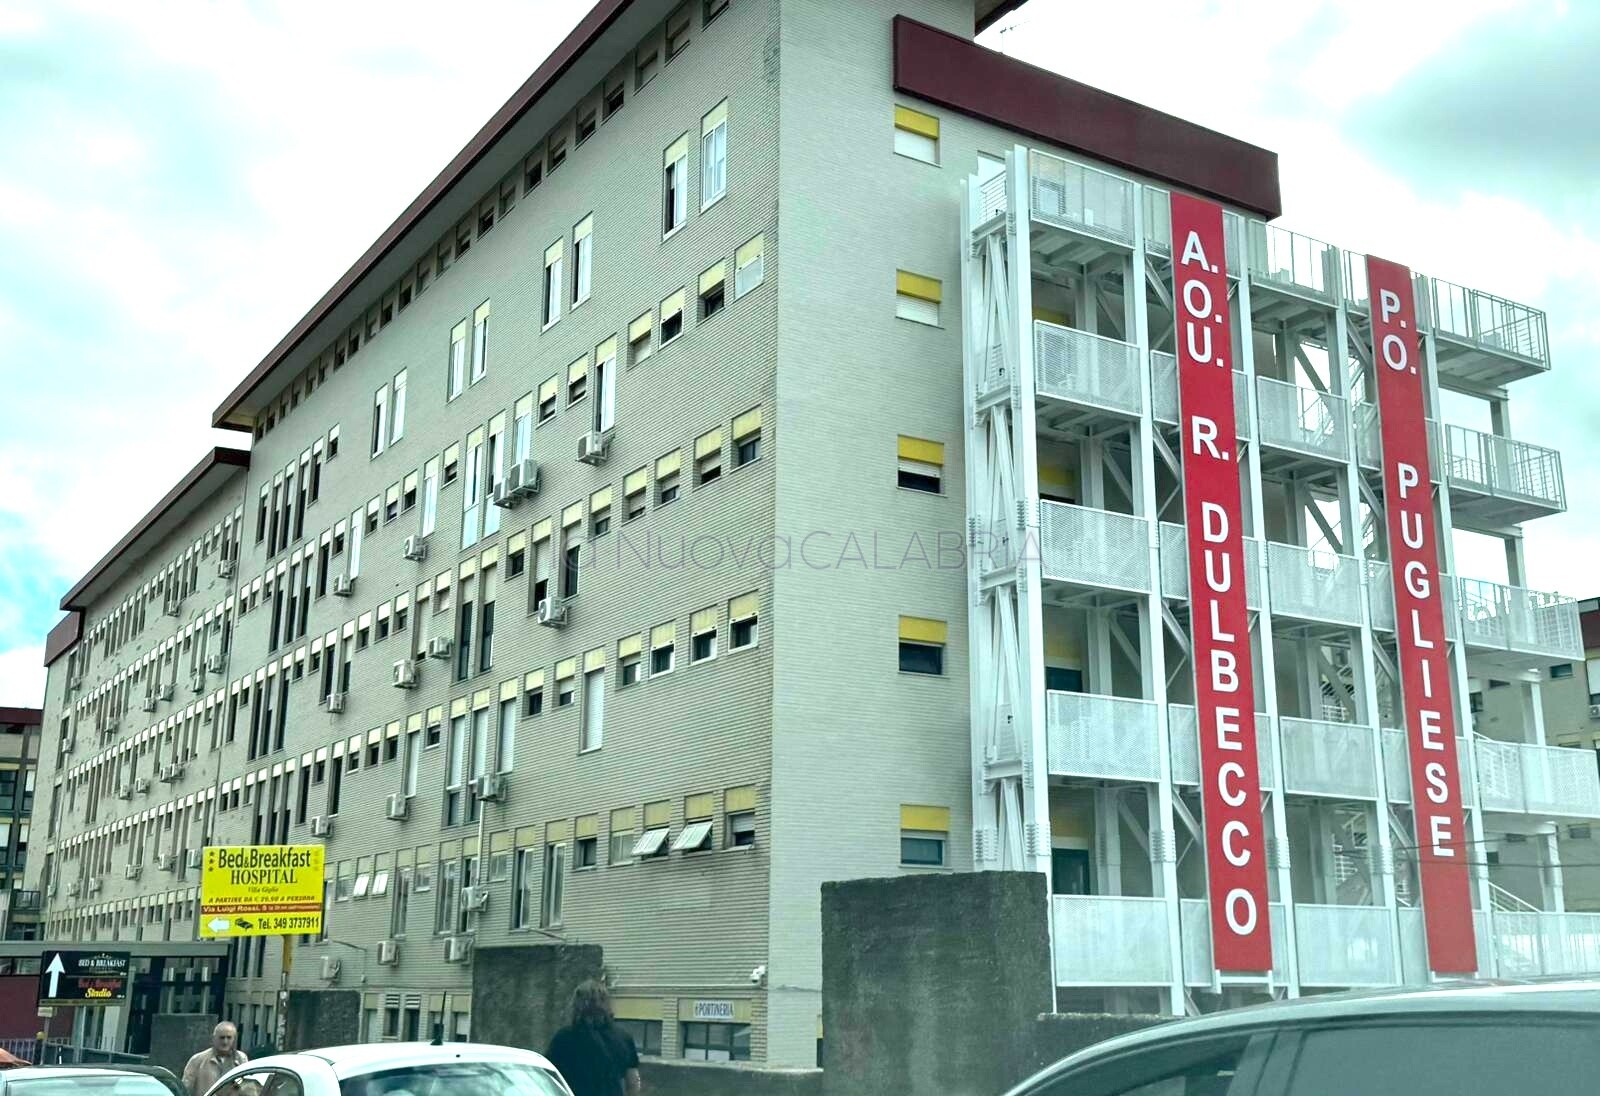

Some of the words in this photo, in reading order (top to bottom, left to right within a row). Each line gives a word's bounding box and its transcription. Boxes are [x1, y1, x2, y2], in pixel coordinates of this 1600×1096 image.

[1379, 288, 1417, 375] P.O.
[1191, 415, 1230, 461] R.
[1397, 462, 1455, 857] PUGLIESE
[1201, 501, 1258, 936] DULBECCO
[231, 869, 298, 885] HOSPITAL
[258, 918, 272, 930] Tel.
[273, 918, 287, 929] 349
[289, 917, 319, 929] 3737911
